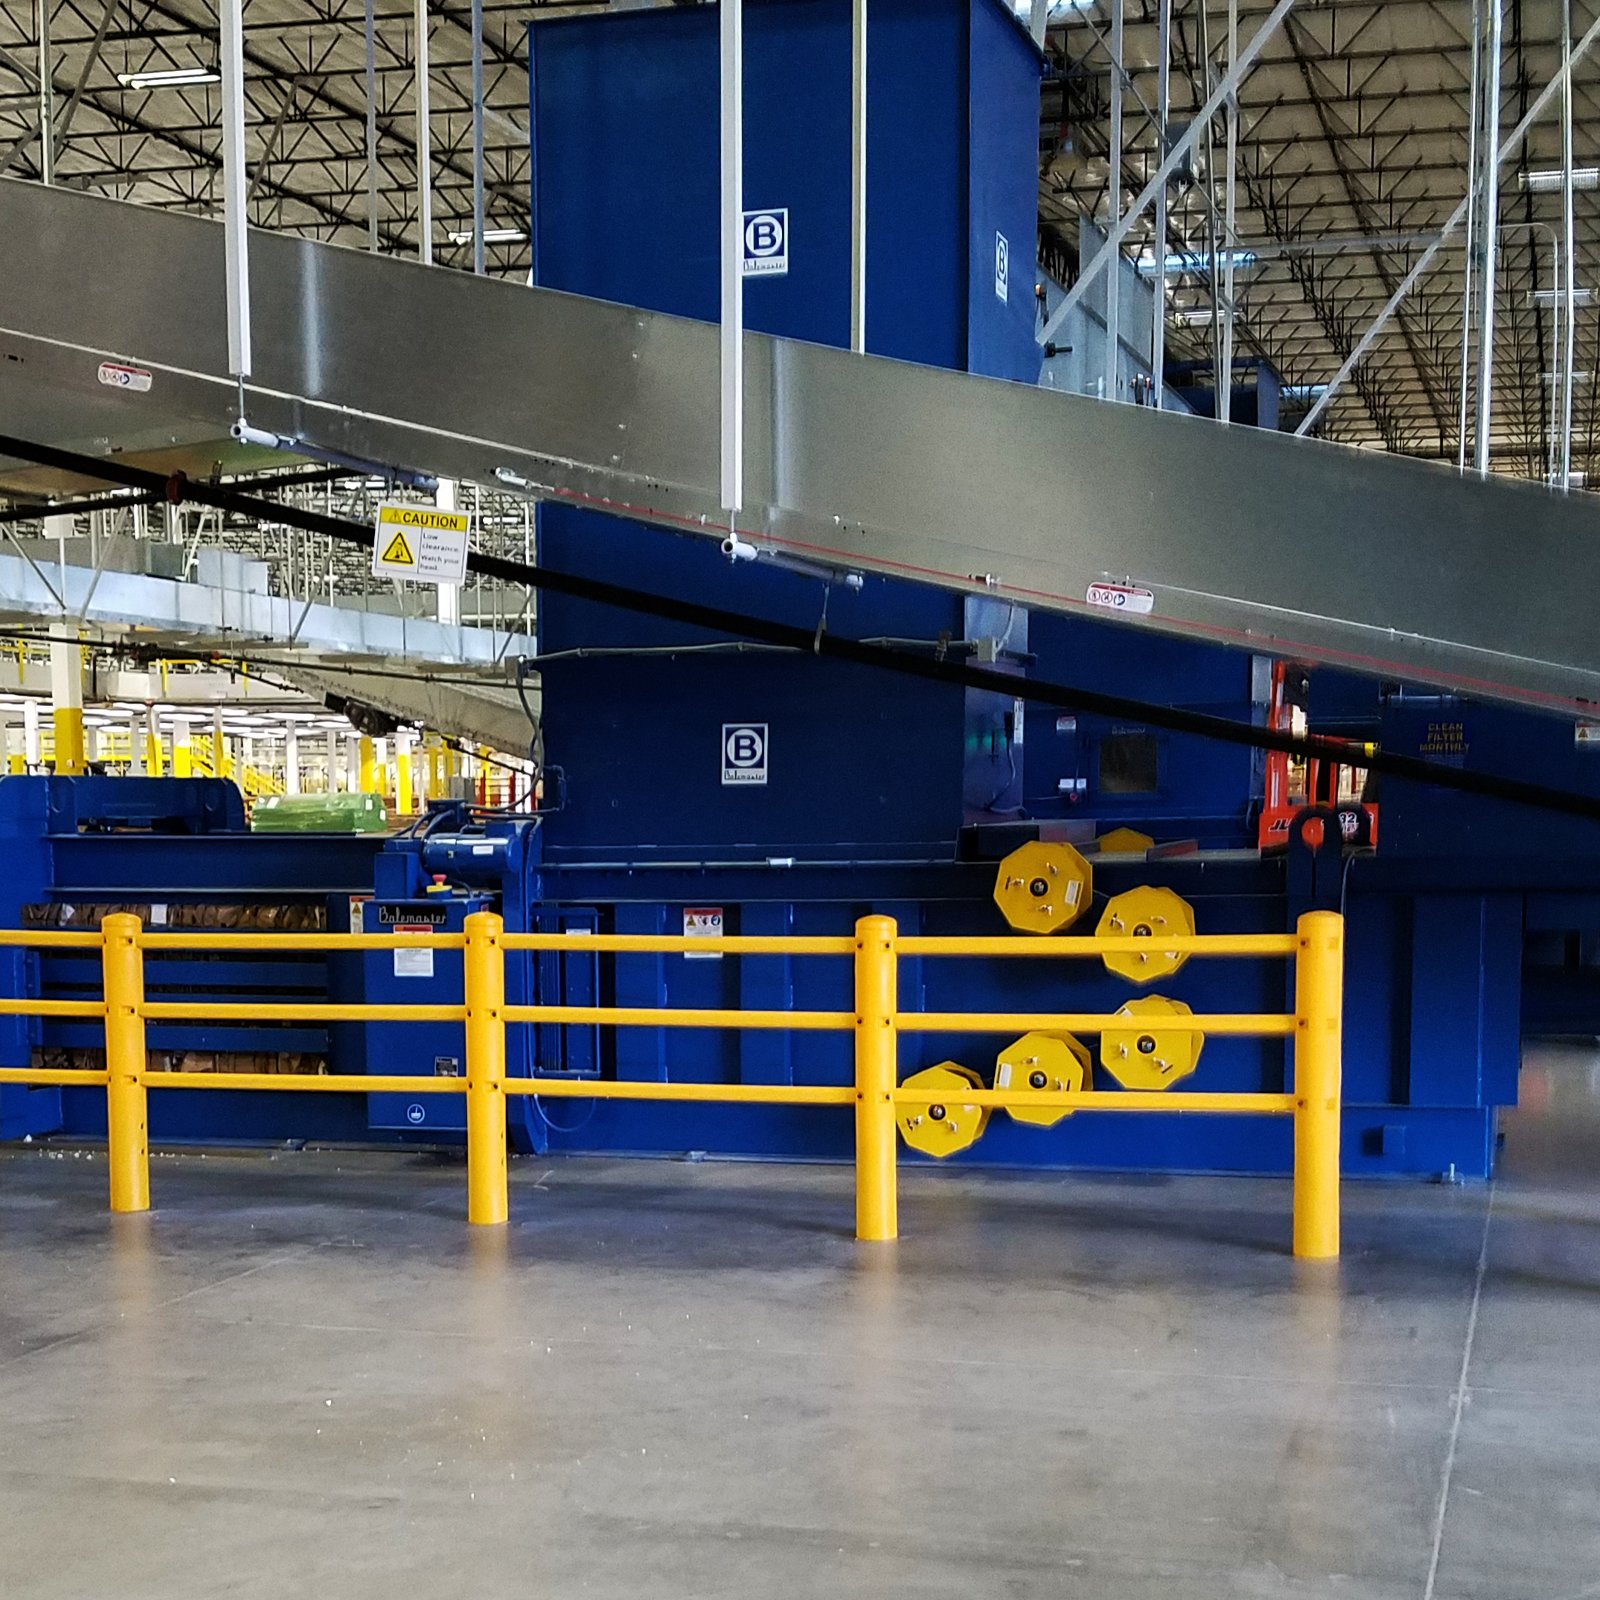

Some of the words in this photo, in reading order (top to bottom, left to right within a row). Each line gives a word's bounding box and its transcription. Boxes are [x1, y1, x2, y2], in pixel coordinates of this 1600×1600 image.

[753, 222, 777, 251] B
[402, 511, 458, 529] CAUTION
[1428, 722, 1464, 732] CLEAN
[1427, 732, 1463, 743] FILTER
[733, 734, 758, 761] B
[1419, 742, 1471, 753] MONTHLY
[378, 905, 447, 925] Balemaster
